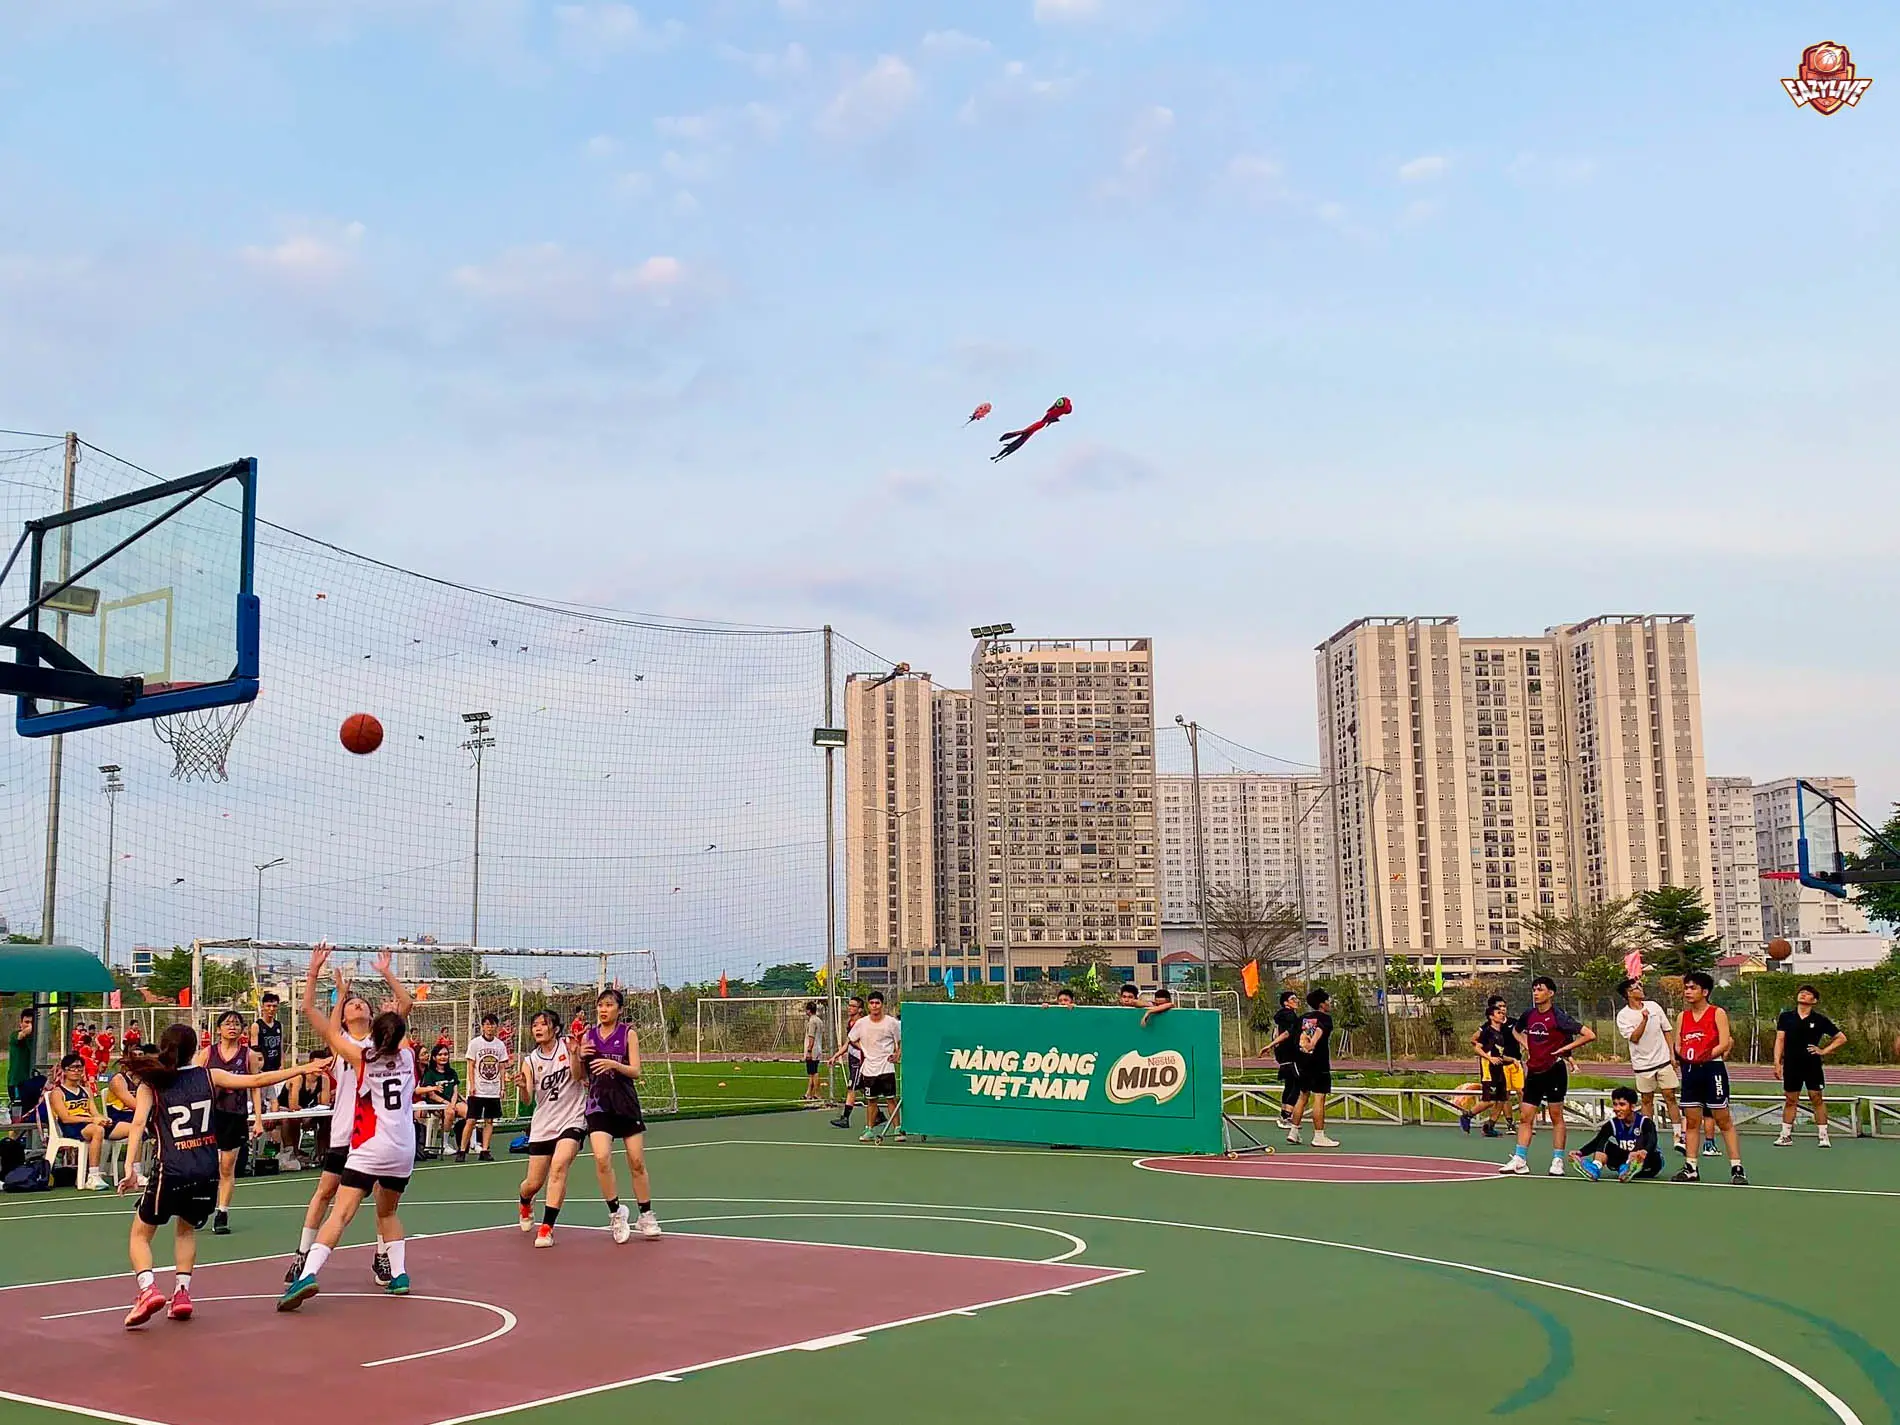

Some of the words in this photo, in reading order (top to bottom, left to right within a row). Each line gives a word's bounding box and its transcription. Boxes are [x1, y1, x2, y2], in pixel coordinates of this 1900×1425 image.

[949, 1045, 1020, 1072] NĂNG
[1021, 1047, 1098, 1077] ĐỘNG
[968, 1072, 1027, 1100] VIỆT
[1027, 1077, 1090, 1100] NAM
[1117, 1066, 1178, 1090] MILO
[383, 1079, 402, 1110] 6
[168, 1100, 212, 1138] 27
